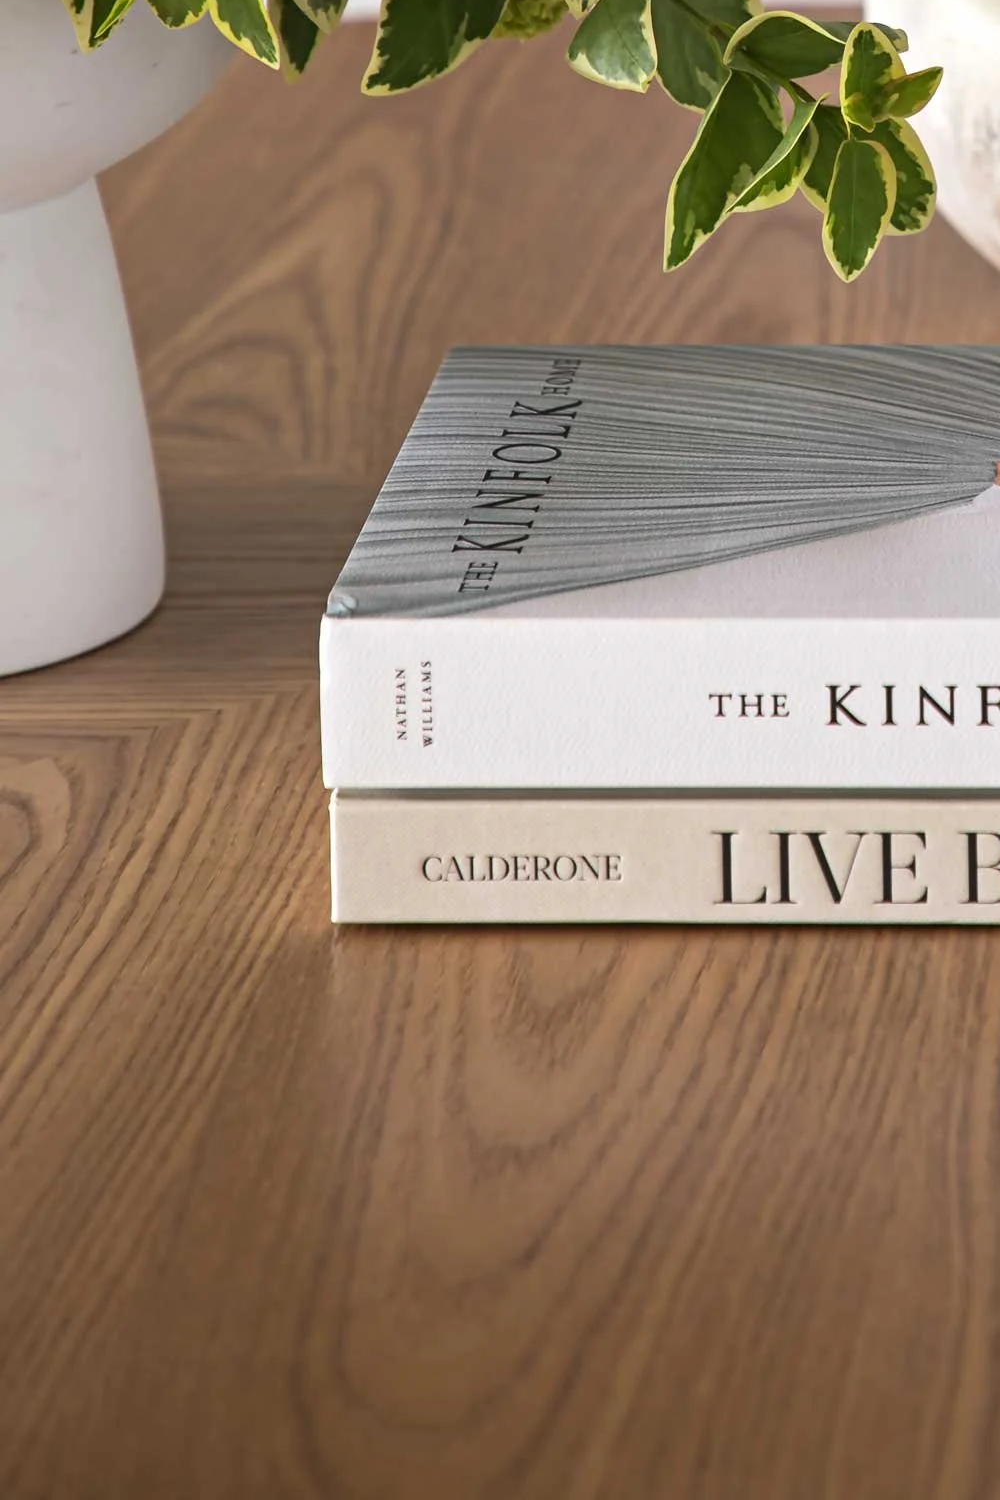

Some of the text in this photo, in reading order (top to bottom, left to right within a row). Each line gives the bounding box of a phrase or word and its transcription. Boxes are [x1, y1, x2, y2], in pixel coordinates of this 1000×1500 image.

[451, 359, 583, 593] THE KINFOLK HOME
[395, 667, 407, 741] NATHAN
[421, 660, 433, 748] WILLIAMS
[708, 693, 790, 718] THE
[421, 854, 623, 884] CALDERONE
[710, 830, 929, 906] LIVE
